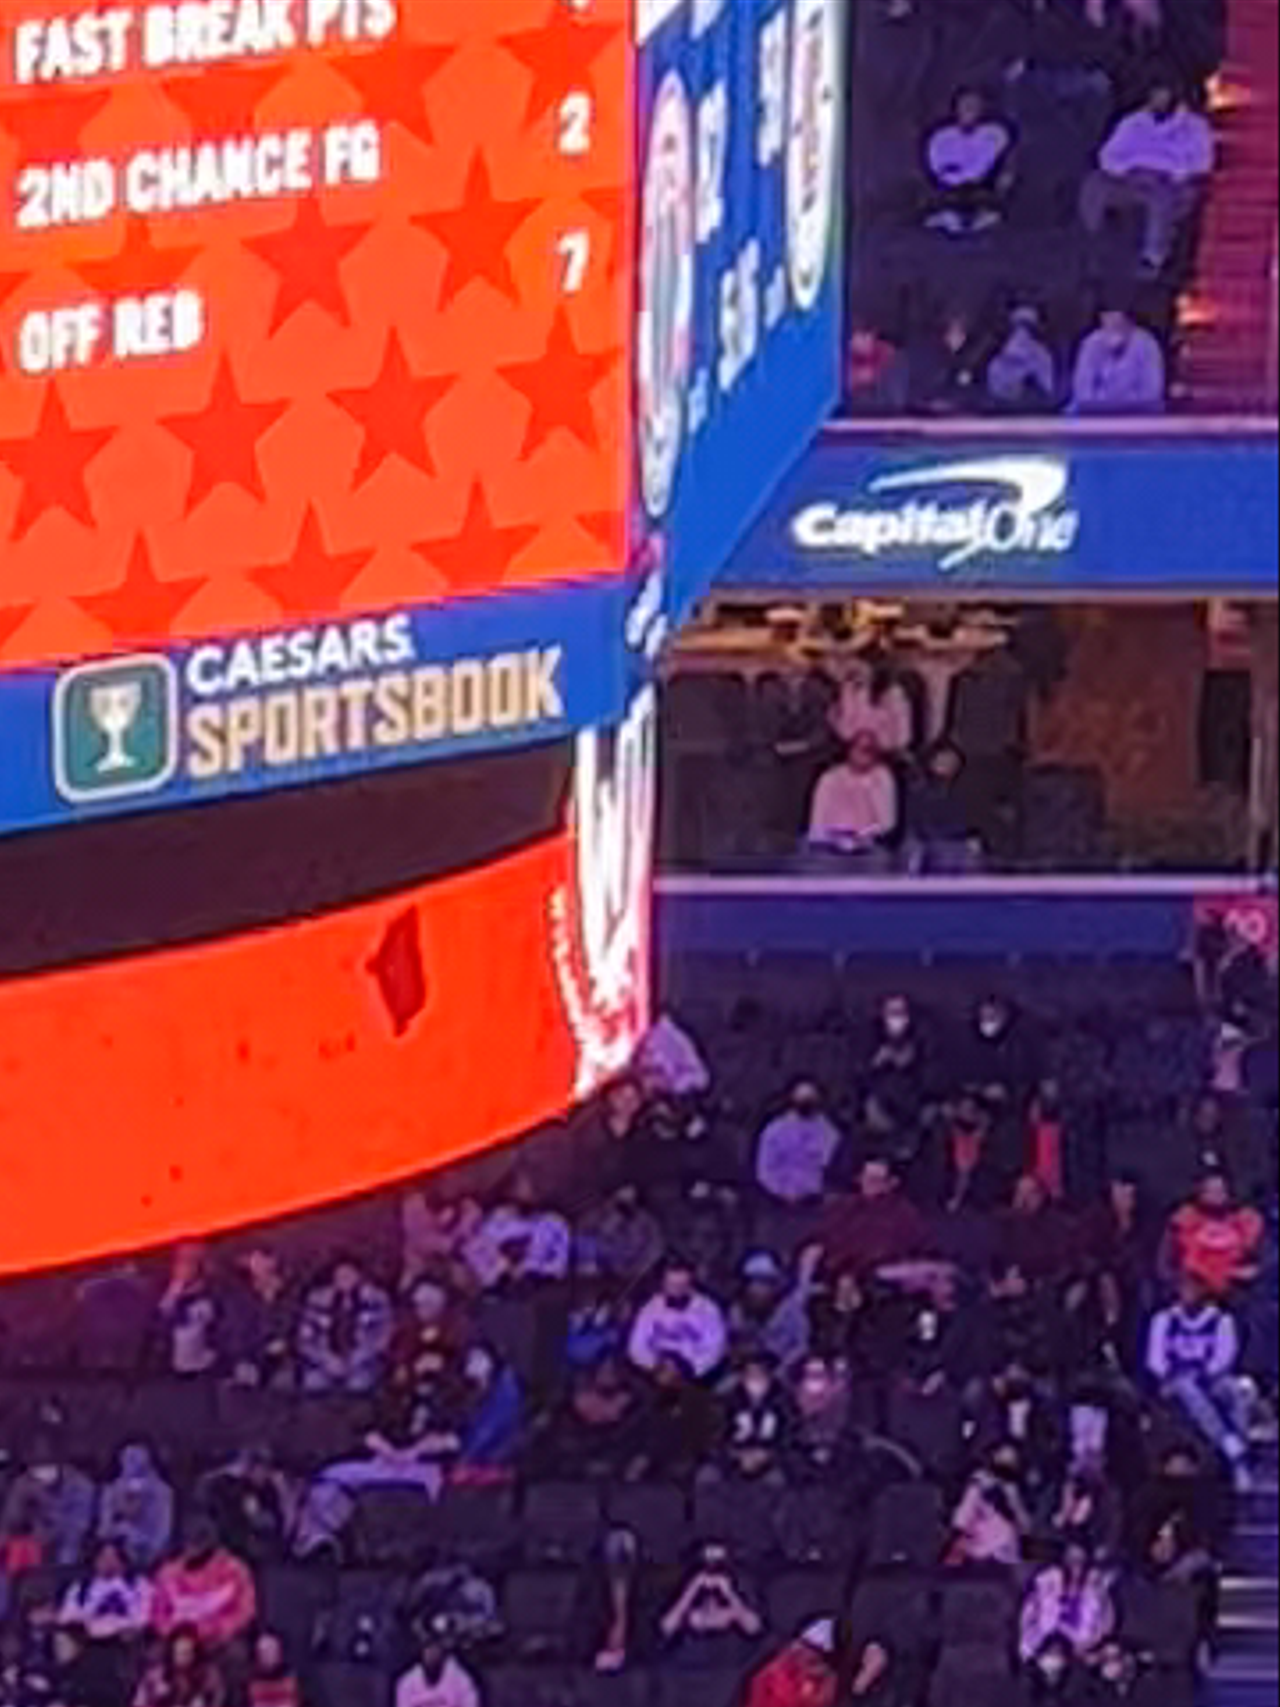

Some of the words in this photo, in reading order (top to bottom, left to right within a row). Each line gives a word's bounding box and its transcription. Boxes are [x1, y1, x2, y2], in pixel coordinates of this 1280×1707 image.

[13, 8, 133, 84] FAST
[141, 0, 298, 66] BREAK
[304, 0, 399, 43] PTS
[557, 92, 592, 157] 2
[14, 158, 114, 229] 2ND
[125, 130, 314, 213] CHANCE
[322, 120, 384, 187] FG
[554, 230, 592, 294] 7
[17, 303, 101, 373] OFF
[112, 289, 205, 358] REB
[792, 503, 985, 570] Capital
[983, 505, 1080, 556] One
[187, 615, 413, 694] CAESARS
[188, 646, 564, 779] SPORTSBOOK
